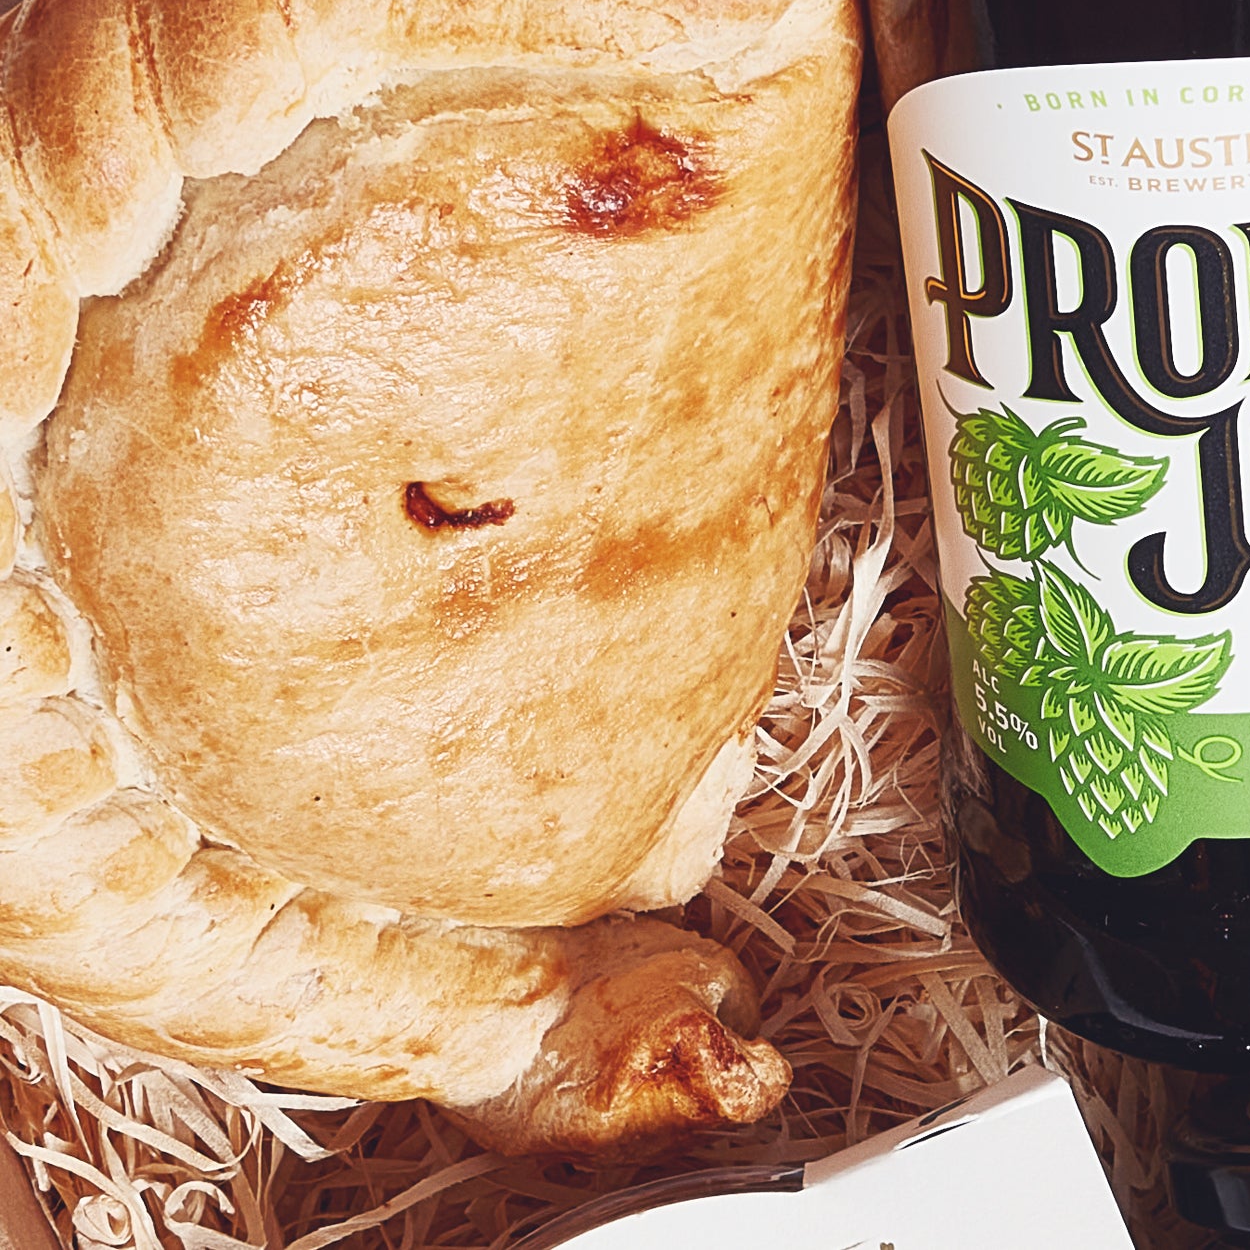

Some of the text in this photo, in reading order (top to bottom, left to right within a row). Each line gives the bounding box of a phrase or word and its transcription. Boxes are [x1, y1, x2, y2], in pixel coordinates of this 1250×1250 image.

[1023, 90, 1108, 113] BORN
[1126, 87, 1160, 107] IN
[1088, 174, 1119, 188] EST.
[972, 658, 1000, 695] ALC
[974, 681, 1039, 751] 5.5%
[977, 714, 1007, 754] VOL
